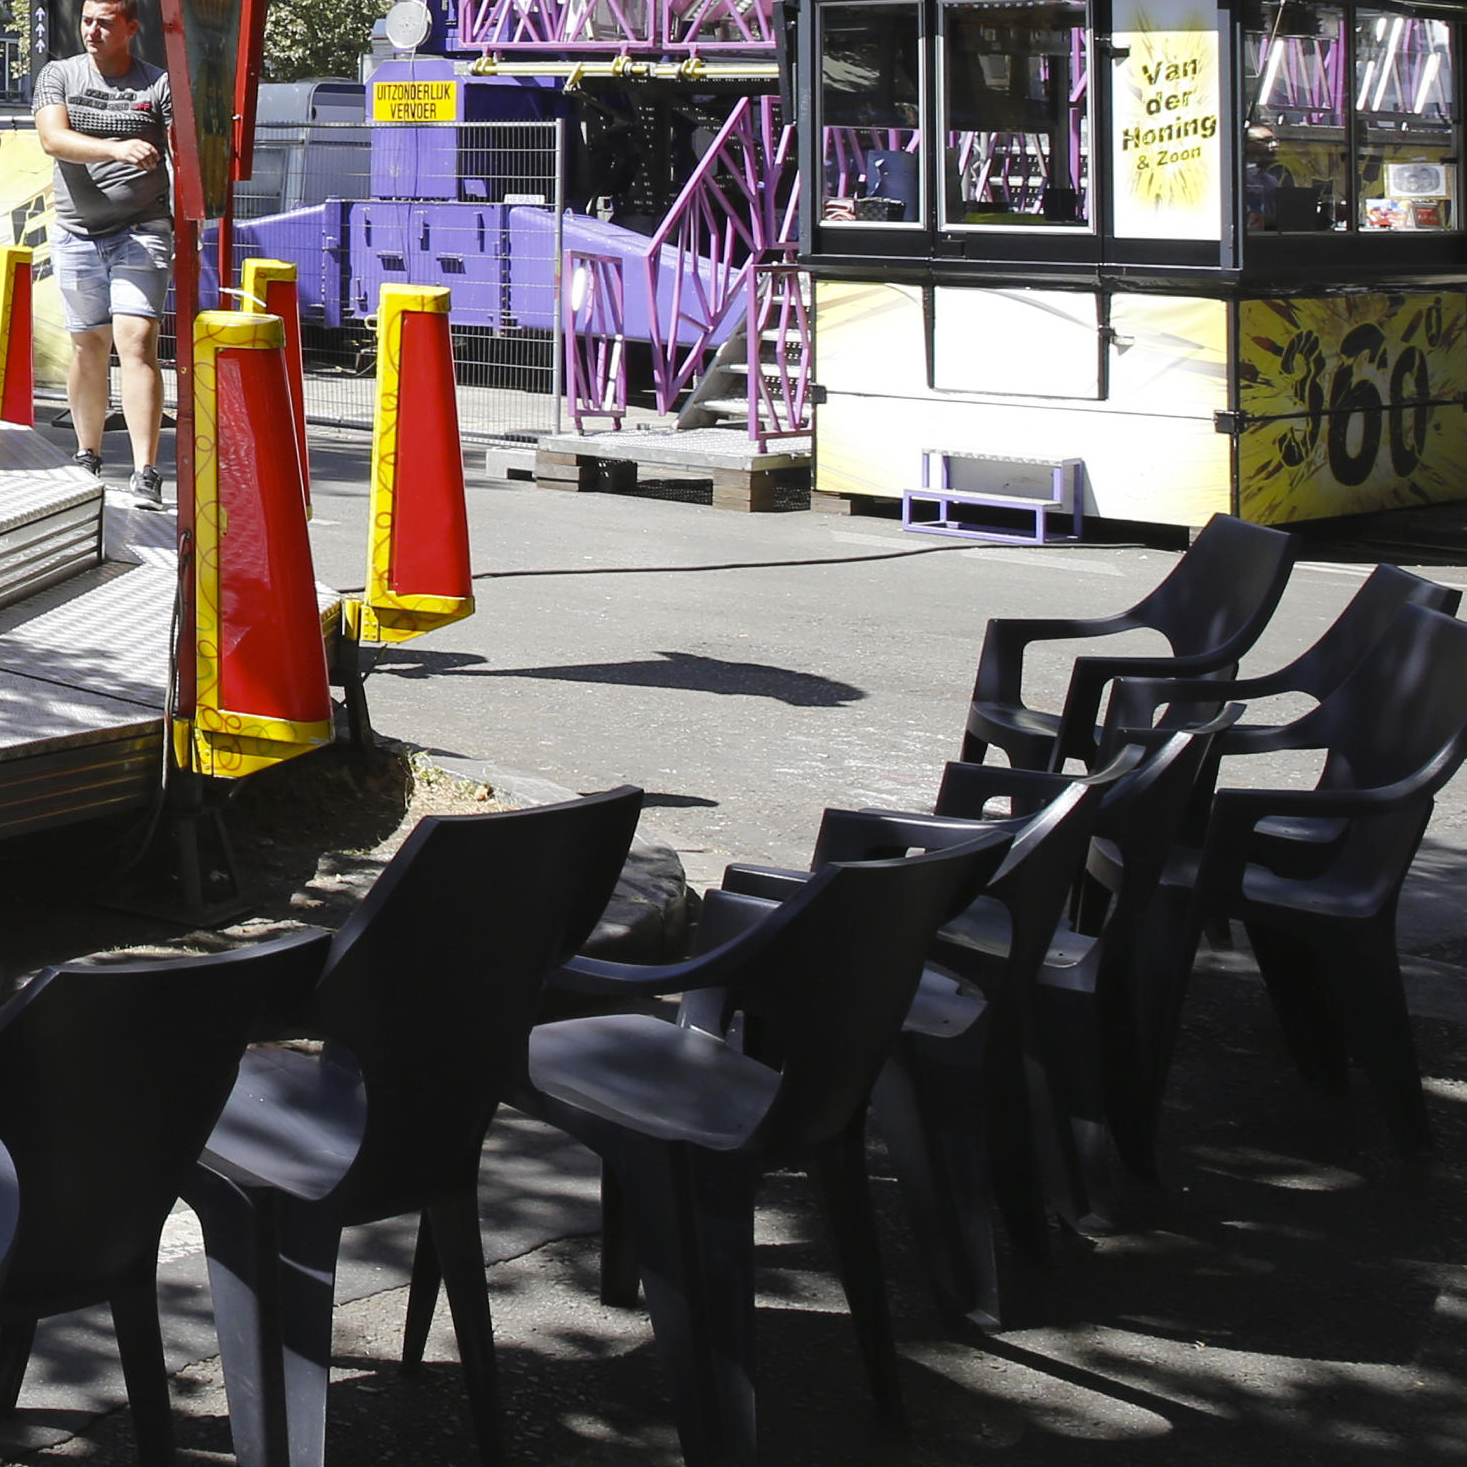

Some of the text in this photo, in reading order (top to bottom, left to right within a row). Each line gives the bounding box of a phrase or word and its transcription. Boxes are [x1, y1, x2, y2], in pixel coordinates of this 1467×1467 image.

[1142, 58, 1198, 85] Van
[377, 84, 451, 101] UITZONDERLIJK
[1146, 91, 1193, 115] der
[390, 103, 437, 119] VERVOER
[1122, 115, 1217, 151] Honing
[1137, 146, 1202, 170] & Zoon
